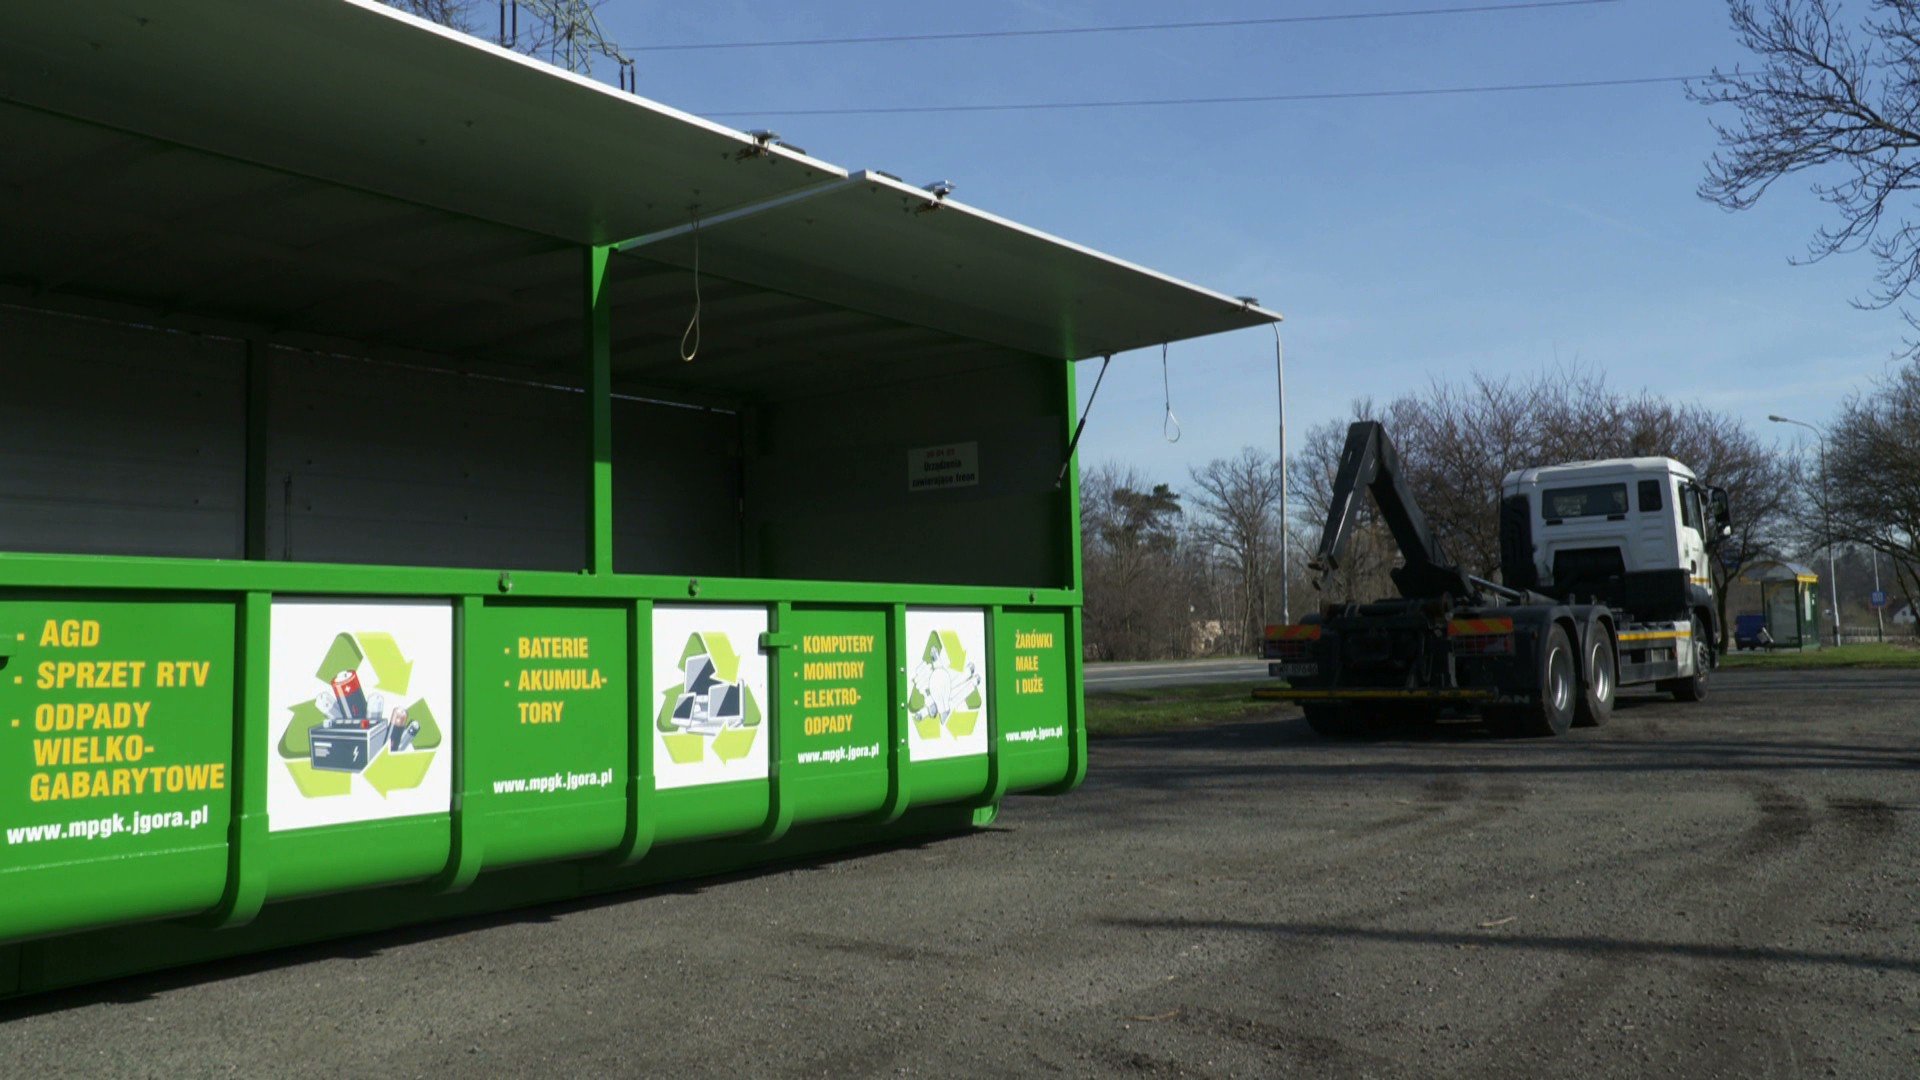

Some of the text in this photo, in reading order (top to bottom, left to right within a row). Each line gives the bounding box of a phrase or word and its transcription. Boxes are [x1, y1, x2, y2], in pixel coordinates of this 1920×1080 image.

[956, 472, 975, 482] freon
[40, 619, 100, 647] AGD
[1015, 630, 1052, 649] ŻARÓWKI
[518, 637, 589, 658] BATERIE
[803, 635, 874, 653] KOMPUTERY
[804, 661, 864, 680] MONITORY
[1016, 655, 1038, 672] MAŁE
[37, 661, 210, 689] SPRZET RTV
[518, 668, 607, 691] AKUMULA-
[1022, 674, 1043, 693] DUŻE
[804, 688, 861, 708] ELEKTRO-
[35, 701, 151, 732] ODPADY
[518, 701, 564, 724] TORY
[804, 714, 852, 736] ODPADY
[1006, 726, 1062, 741] www.mpgk.jgora.pl
[33, 734, 154, 767] WIELKO-
[798, 743, 879, 763] www.mpgk.jgora.pl
[30, 762, 225, 802] GABARYTOWE
[493, 768, 612, 793] www.mpgk.jgora.pl
[7, 805, 208, 844] www.mpgk.jgora.pl
